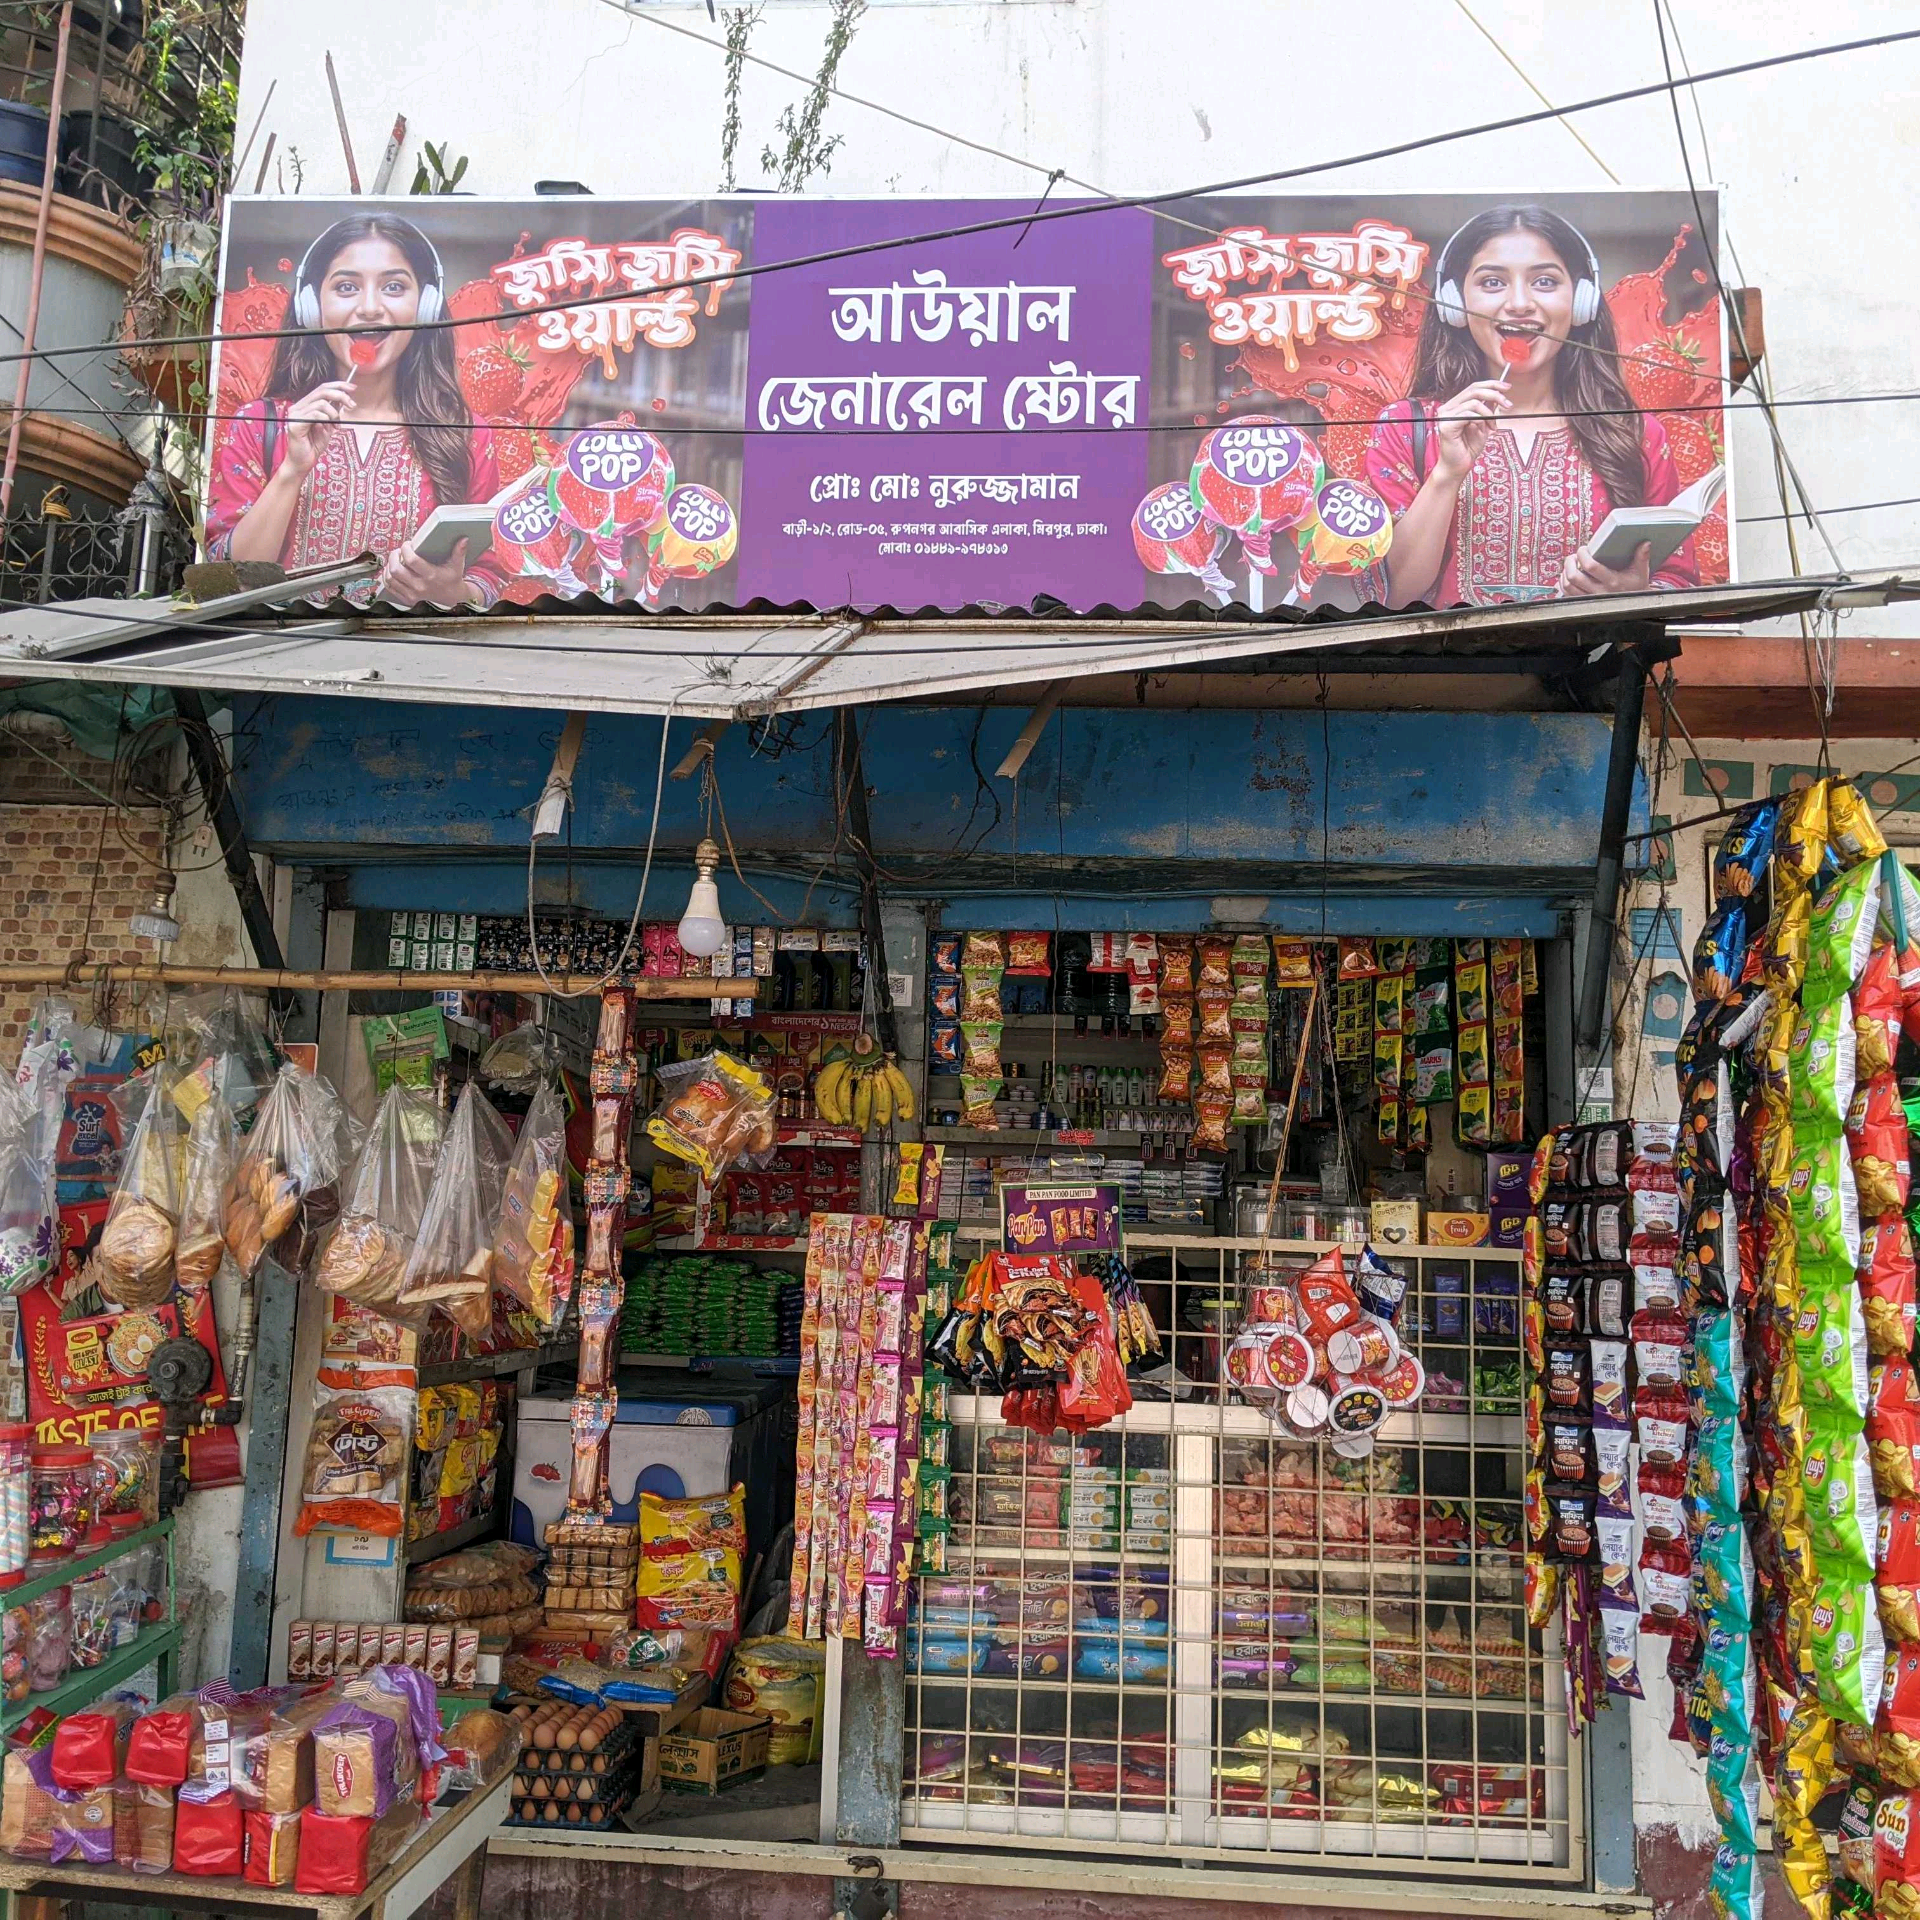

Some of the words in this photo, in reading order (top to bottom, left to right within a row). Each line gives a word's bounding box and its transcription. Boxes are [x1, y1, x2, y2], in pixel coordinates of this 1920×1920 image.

[828, 269, 1076, 348] আউয়াল
[758, 371, 988, 431] জেনারেল
[1003, 360, 1140, 431] ষ্টোর
[577, 434, 644, 453] LOLLI
[1219, 428, 1291, 448] LOLLI
[580, 452, 642, 483] POP
[1223, 447, 1289, 478] POP
[810, 473, 860, 503] প্রোঃ
[869, 473, 920, 502] মোঃ
[929, 472, 1081, 508] নুরুজ্জামান
[1143, 486, 1191, 523] LOLLI
[1329, 485, 1380, 518] LOLLI
[503, 492, 548, 526] LOLLI
[671, 502, 717, 539] POP
[679, 490, 726, 523] LOLLI
[1151, 500, 1201, 539] POP
[1321, 497, 1371, 536] POP
[510, 505, 557, 542] POP
[939, 518, 988, 536] আবাসিক
[992, 522, 1031, 537] এলাকা,
[1033, 518, 1074, 539] মিরপুর,
[1076, 522, 1108, 536] ঢাকা।
[878, 541, 911, 555] মোবাঃ
[771, 1016, 820, 1027] বাংলাদেশের
[1421, 1055, 1442, 1065] MARKS
[79, 1119, 100, 1131] Surf
[1029, 1191, 1040, 1199] PAN
[1041, 1190, 1053, 1199] PAN
[1054, 1190, 1068, 1198] FOOD
[1069, 1189, 1092, 1198] LIMITED
[1007, 1212, 1027, 1238] Pan
[1027, 1212, 1047, 1237] Pan
[74, 1354, 99, 1370] BLAST
[86, 1388, 114, 1403] আজই
[35, 1408, 111, 1446] TASTE
[334, 1754, 347, 1798] TALUKDER
[1876, 1803, 1906, 1833] Sun
[1886, 1831, 1905, 1847] Chips
